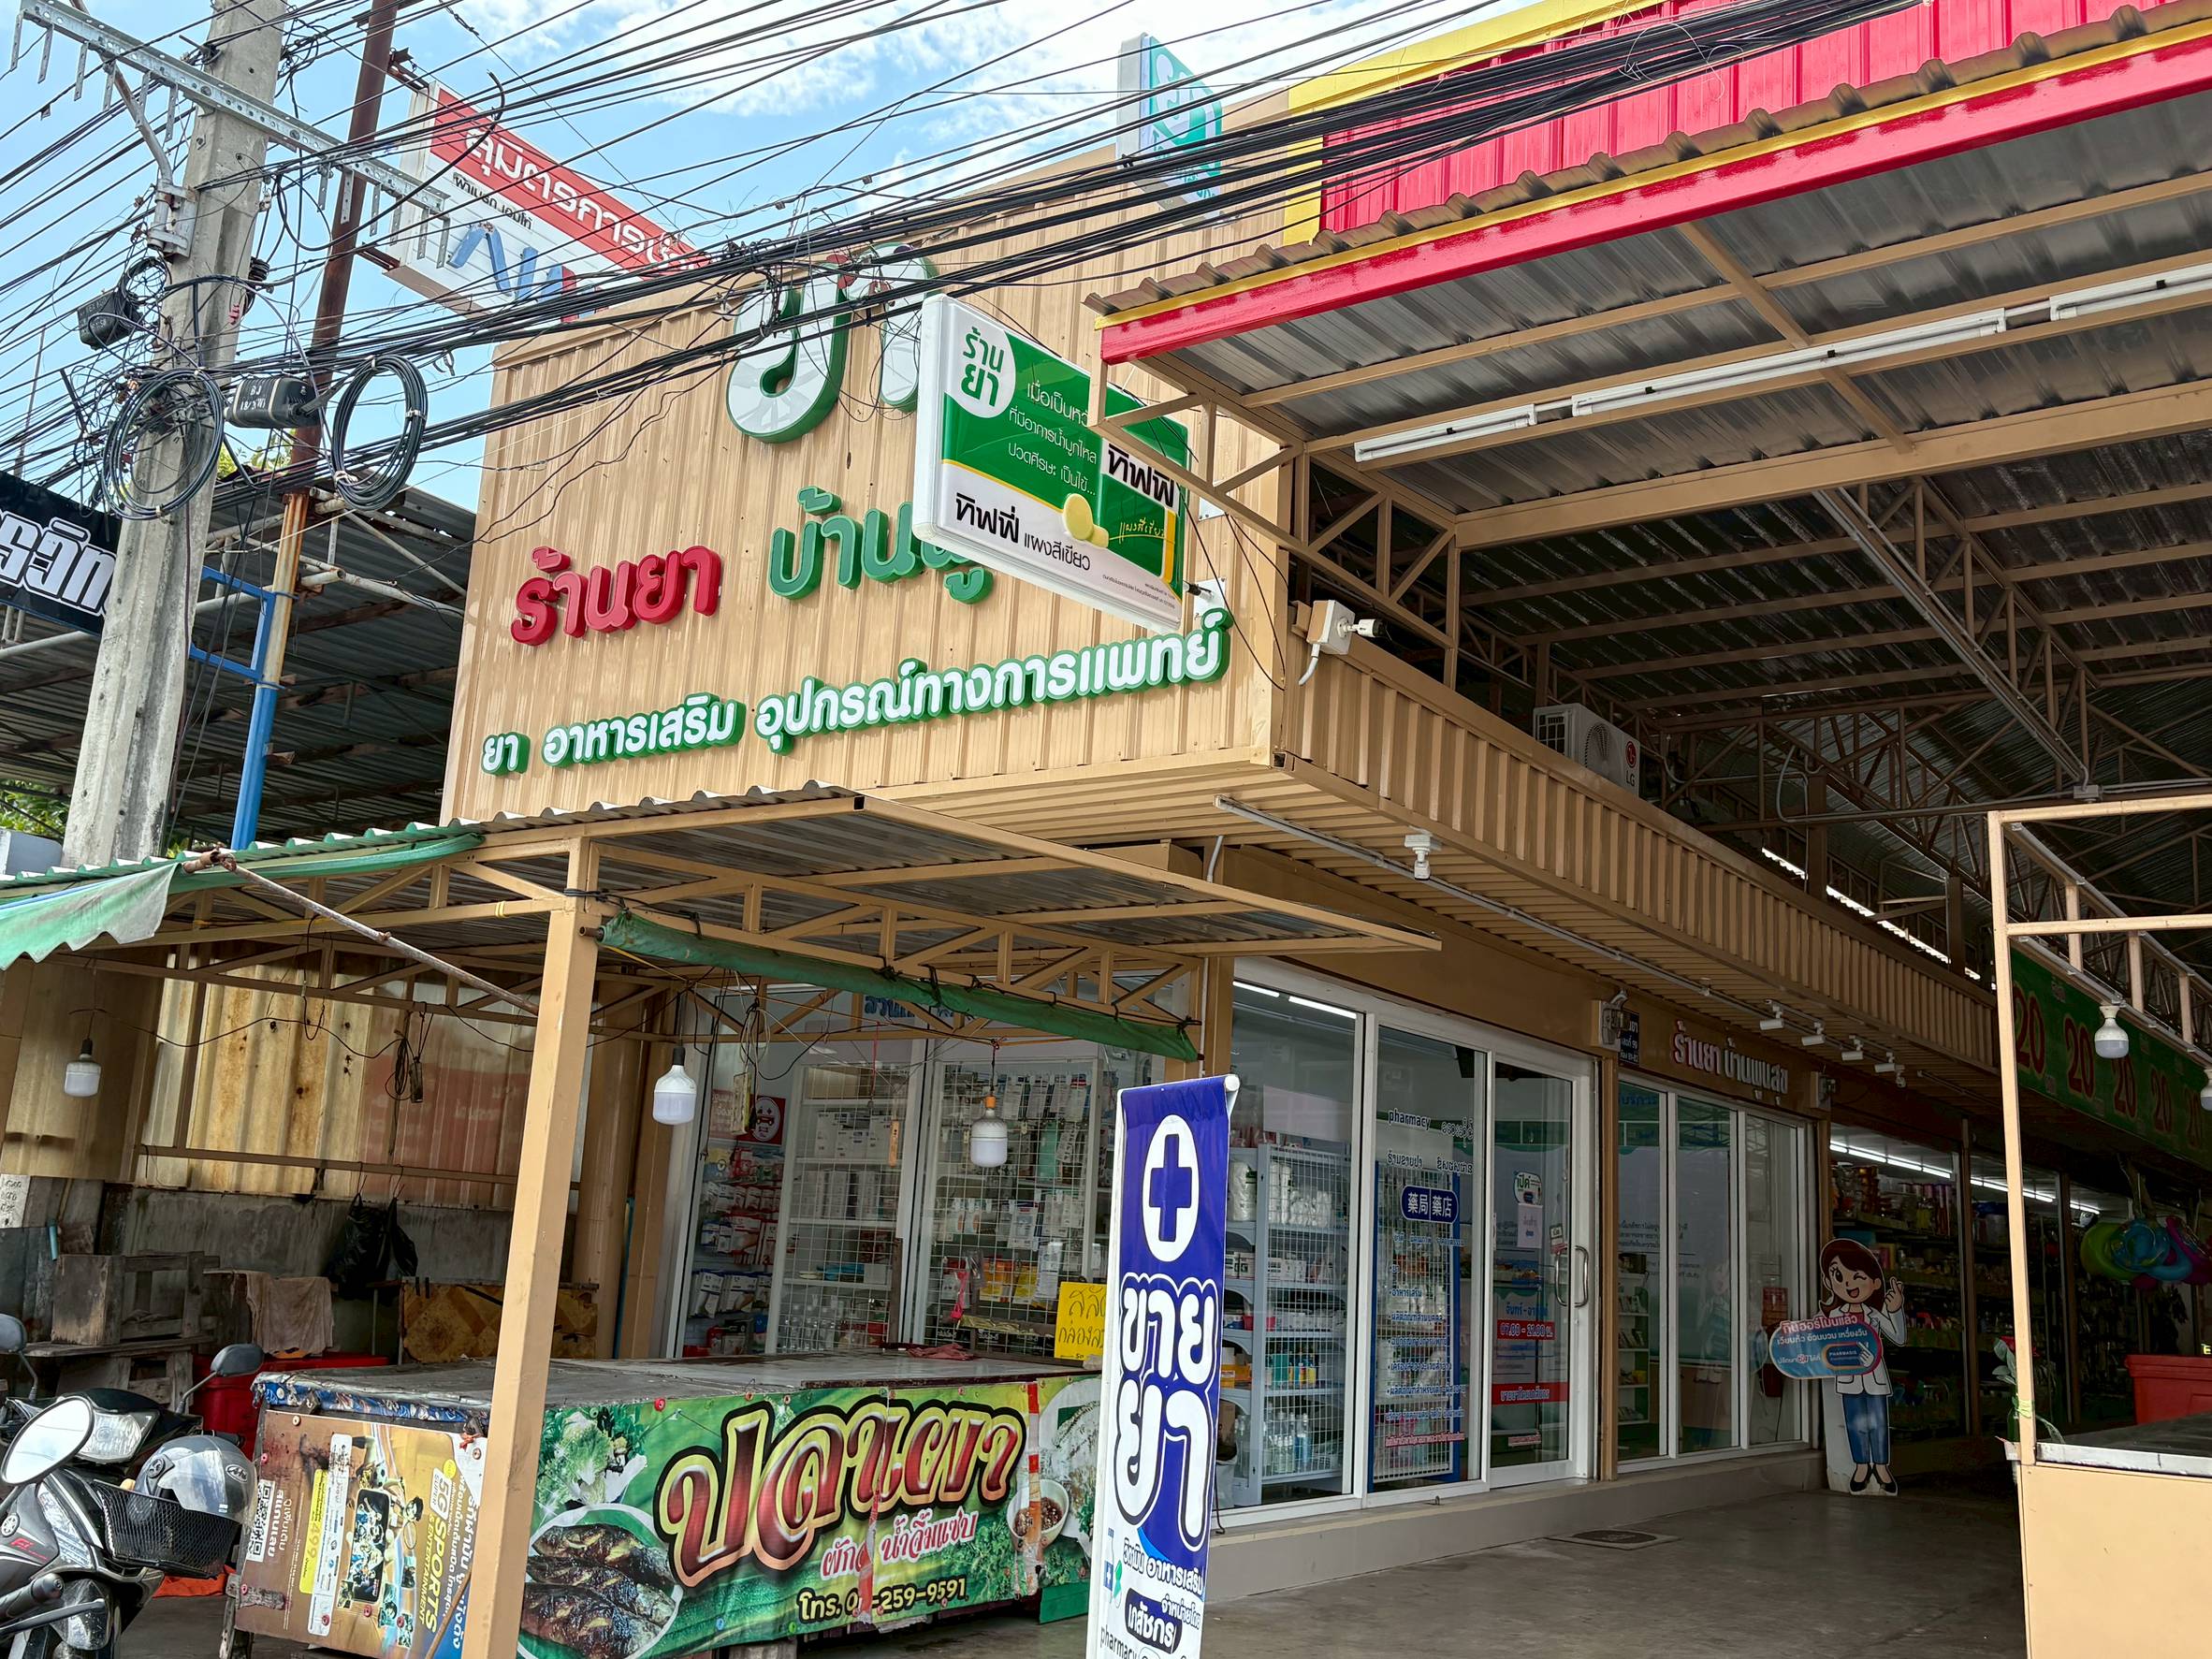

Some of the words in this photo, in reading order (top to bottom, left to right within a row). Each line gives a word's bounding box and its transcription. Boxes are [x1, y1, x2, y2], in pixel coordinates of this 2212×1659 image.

[963, 327, 1004, 372] ร้าน
[961, 363, 998, 407] ยา
[1026, 379, 1088, 428] เมื่อเป็นหวั
[1009, 408, 1097, 465] ที่มีอาการน้ำมูกไหล
[1009, 443, 1056, 475] ปวดศีรษะ
[1108, 444, 1175, 508] ทิฟฟี
[955, 492, 1020, 545] ทิฟฟี่
[1025, 531, 1091, 572] แผงสีเขียว
[511, 546, 721, 646] ร้านยา
[482, 732, 531, 776] ยา
[541, 691, 746, 766] อาหารเสริม
[755, 607, 1231, 754] อุปกรณ์ทางการแพทย์
[1626, 771, 1636, 786] LG
[1673, 1020, 1722, 1075] ร้านยา
[2013, 982, 2045, 1078] 20
[2063, 1013, 2095, 1099] 20
[1389, 1108, 1431, 1130] pharmacy
[2150, 1064, 2173, 1134] 20
[1407, 1192, 1429, 1215] 藥局
[1432, 1196, 1452, 1217] 藥店
[1069, 1287, 1106, 1319] สลั
[1123, 1288, 1215, 1384] ขาย
[1118, 1379, 1209, 1539] ยา
[431, 1473, 440, 1506] SUPER
[437, 1478, 450, 1514] 5G
[657, 1400, 1025, 1587] ปลาเผา
[268, 1490, 284, 1557] สแกนเลย
[308, 1521, 320, 1559] 499
[419, 1521, 433, 1625] ENTERTAINMENT
[426, 1517, 447, 1633] SPORTS
[1146, 1555, 1203, 1595] อาหารเสริม
[798, 1587, 841, 1623] โทร.
[1128, 1601, 1176, 1648] เภสัชกร
